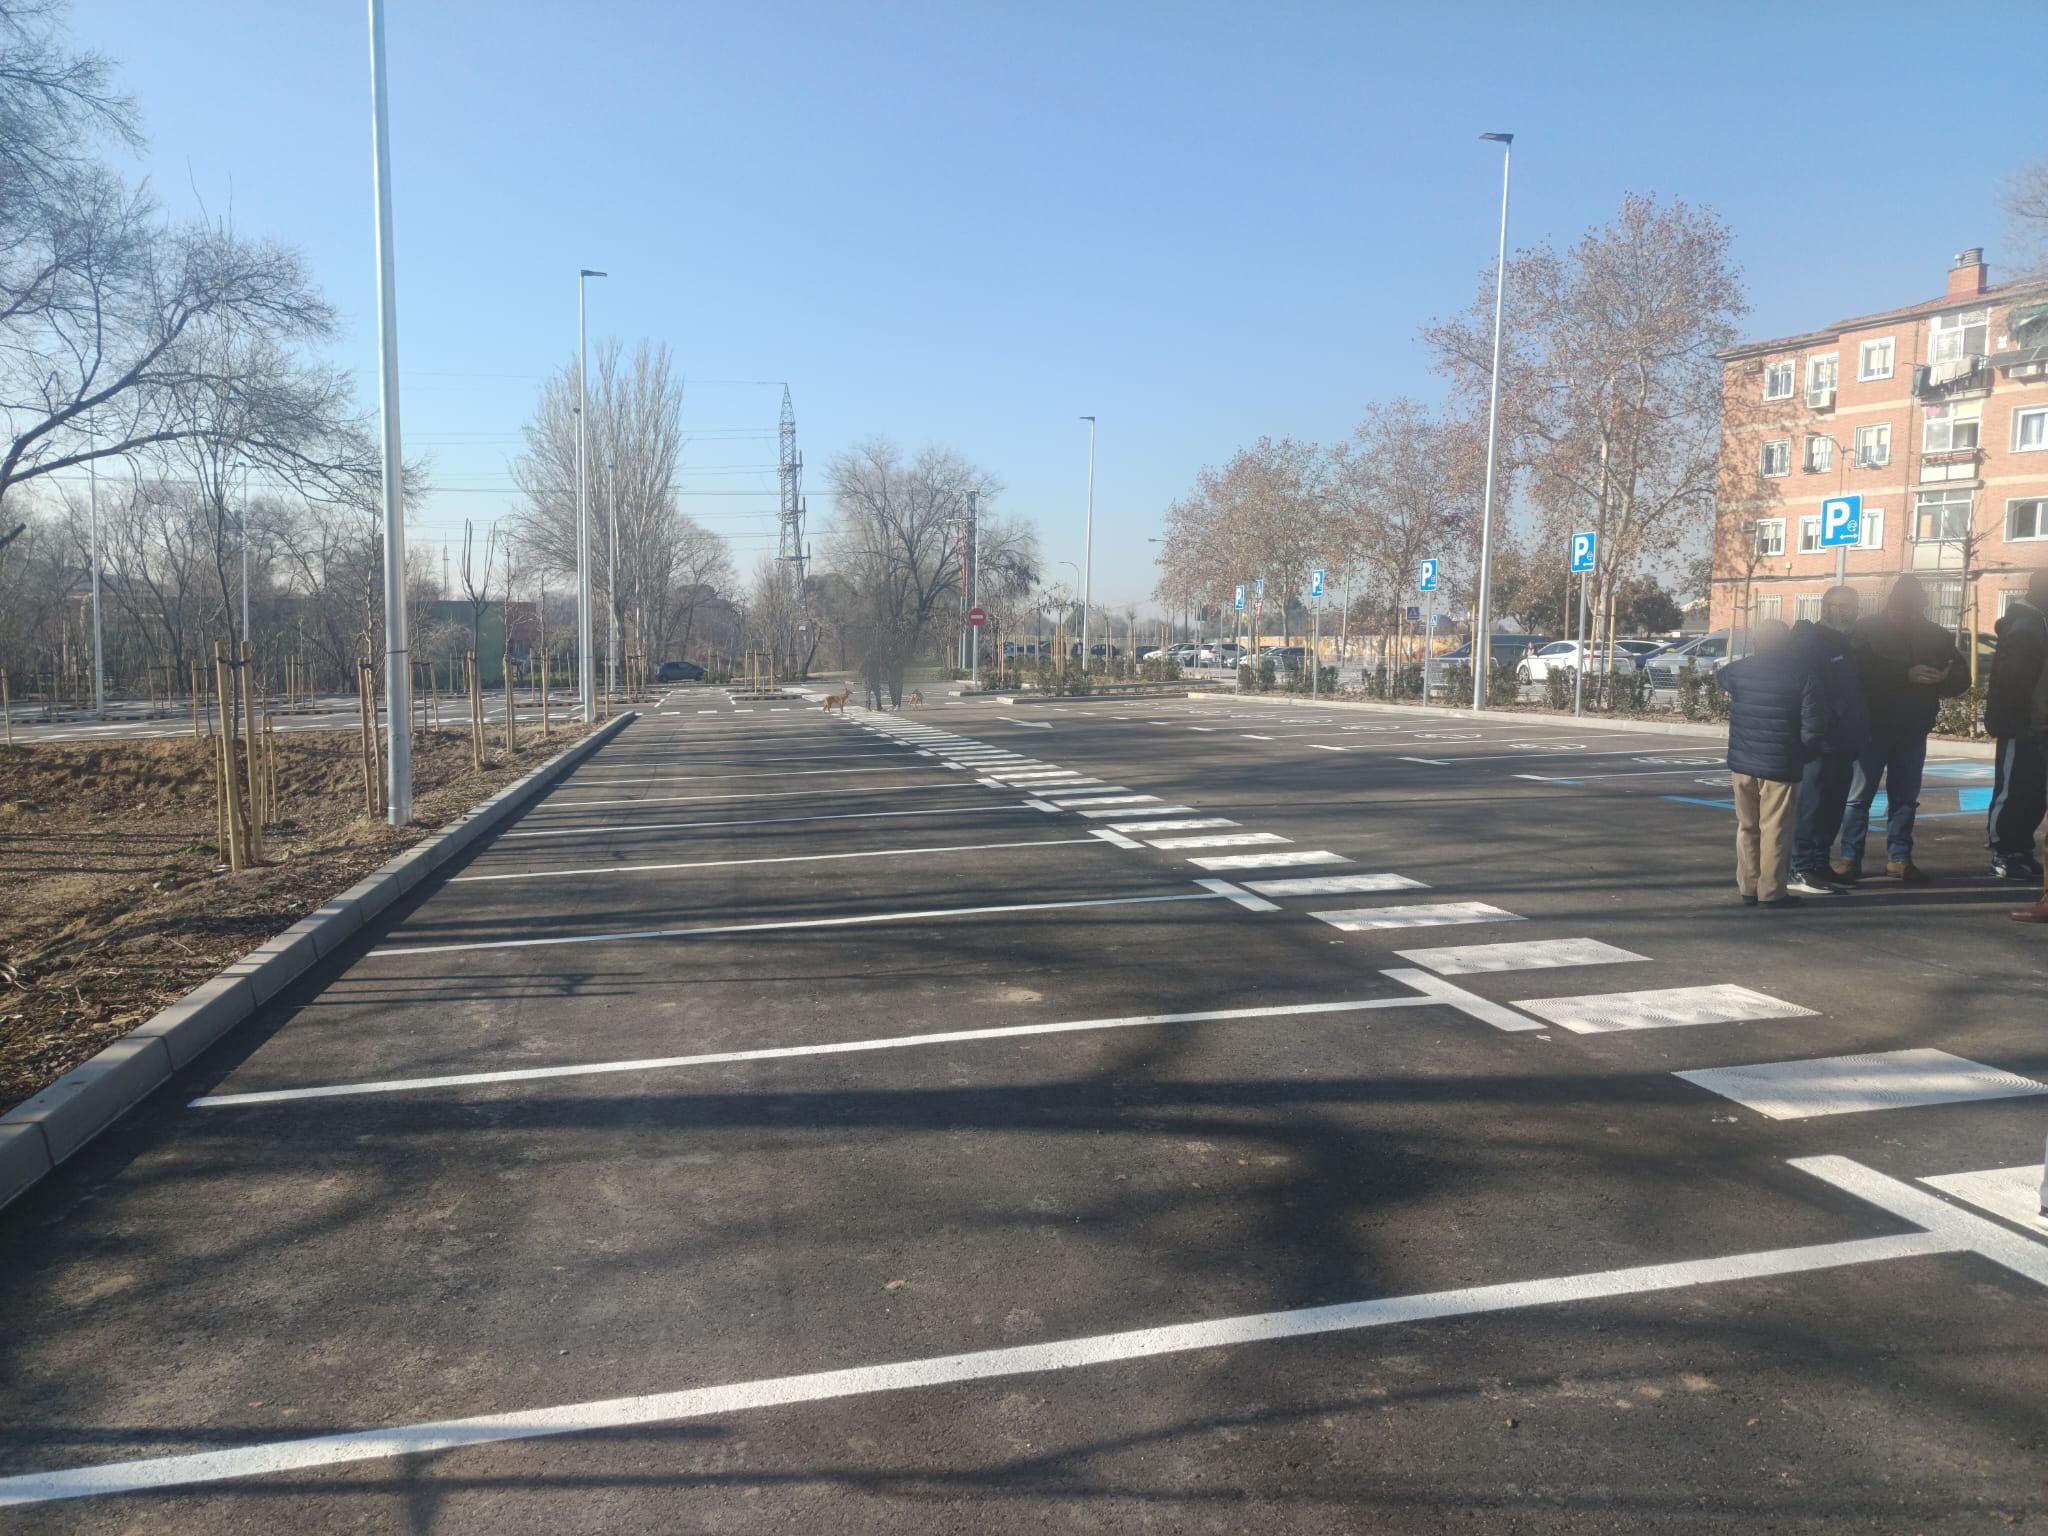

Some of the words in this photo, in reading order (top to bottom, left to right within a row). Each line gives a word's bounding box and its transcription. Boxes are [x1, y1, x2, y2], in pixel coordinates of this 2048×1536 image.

[1825, 501, 1850, 539] P
[1574, 536, 1589, 566] P
[1312, 572, 1321, 594] P
[1421, 562, 1433, 587] P
